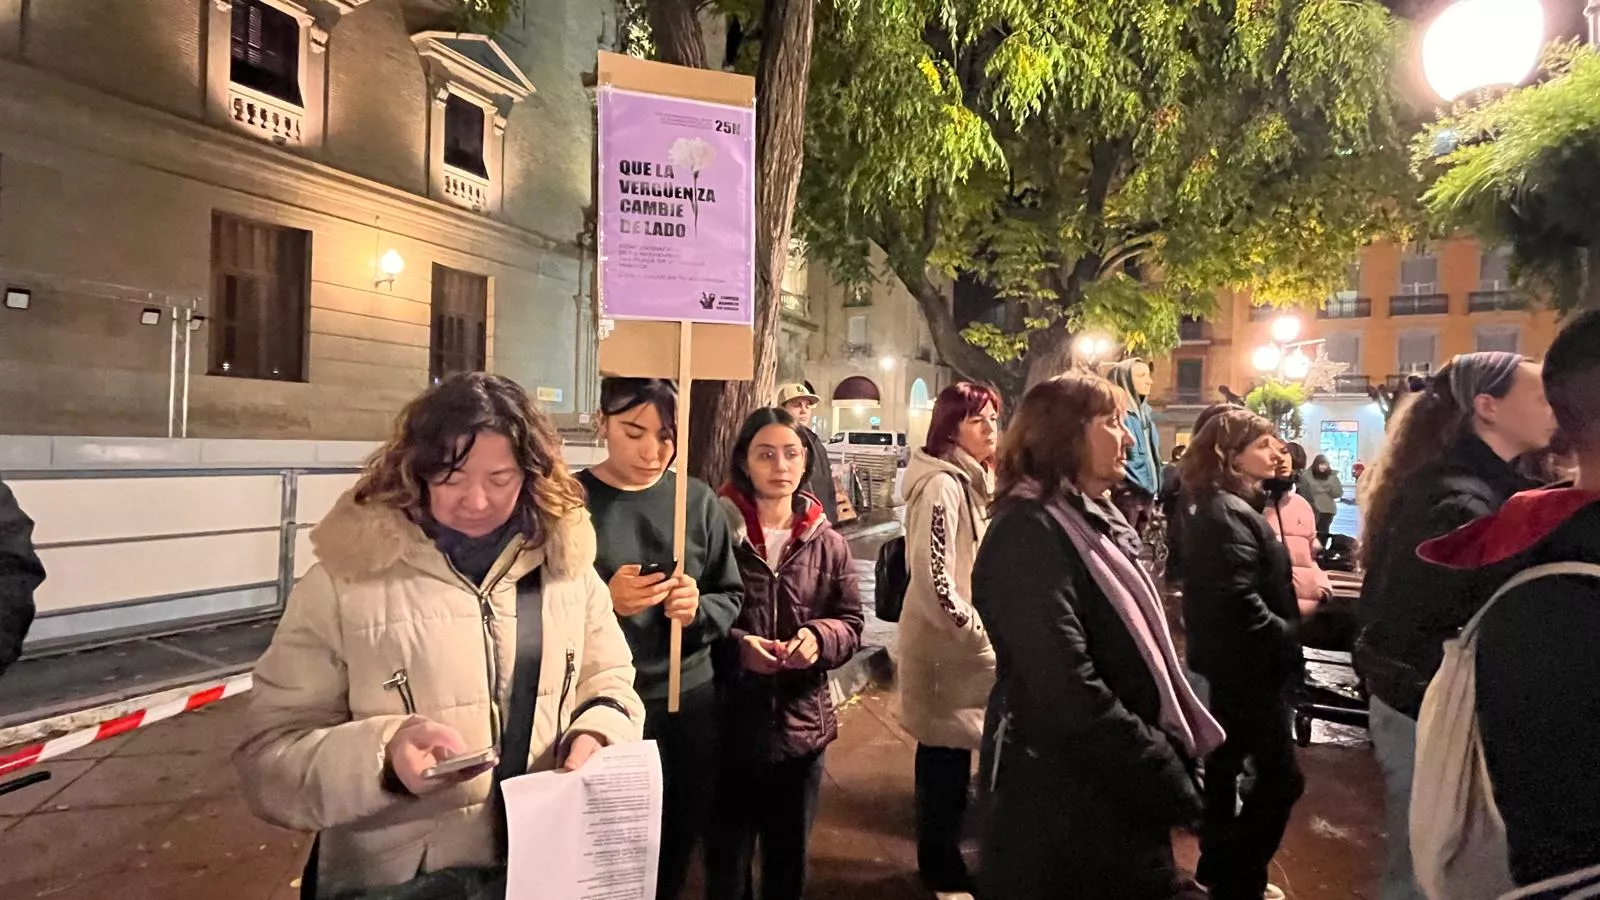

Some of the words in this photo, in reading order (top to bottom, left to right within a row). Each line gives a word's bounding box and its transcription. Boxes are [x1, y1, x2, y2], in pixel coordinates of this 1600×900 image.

[715, 119, 741, 135] 25N
[619, 160, 652, 176] QUE
[655, 163, 675, 179] LA
[619, 179, 716, 203] VERGÜENZA
[620, 199, 684, 217] CAMBIE
[620, 219, 640, 234] DE
[644, 220, 686, 238] LADO
